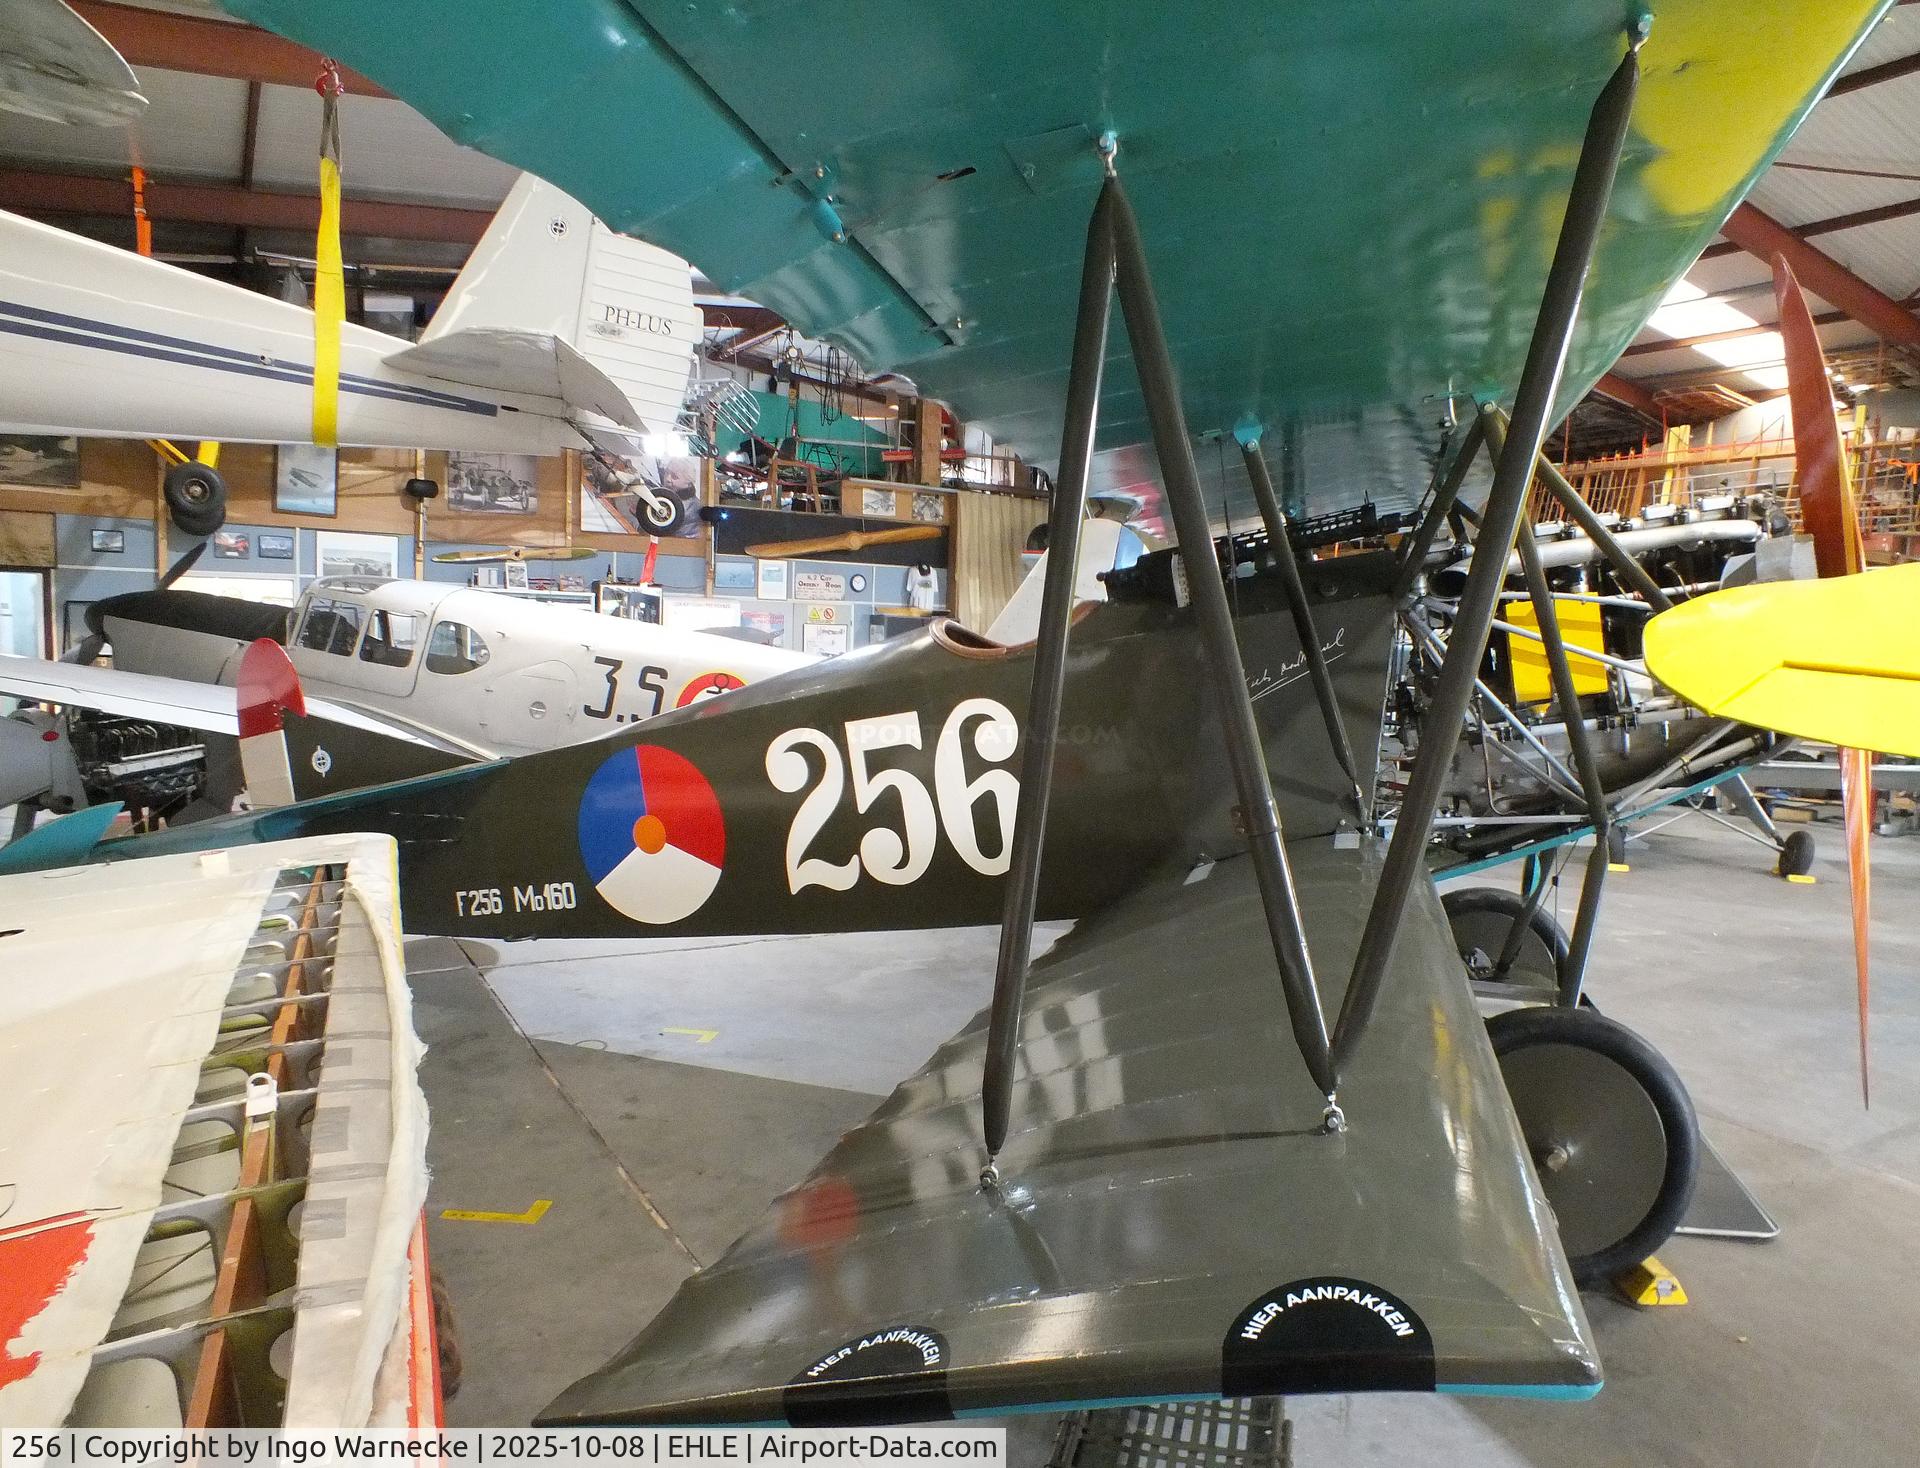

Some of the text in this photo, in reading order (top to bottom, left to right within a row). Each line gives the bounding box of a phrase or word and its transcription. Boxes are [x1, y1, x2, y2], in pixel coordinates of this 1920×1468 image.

[605, 305, 673, 336] PH-LUS
[765, 697, 1021, 895] 256
[1241, 1285, 1415, 1340] HIER AANPAKKEN
[807, 1329, 941, 1377] HIER AANPAKKEN
